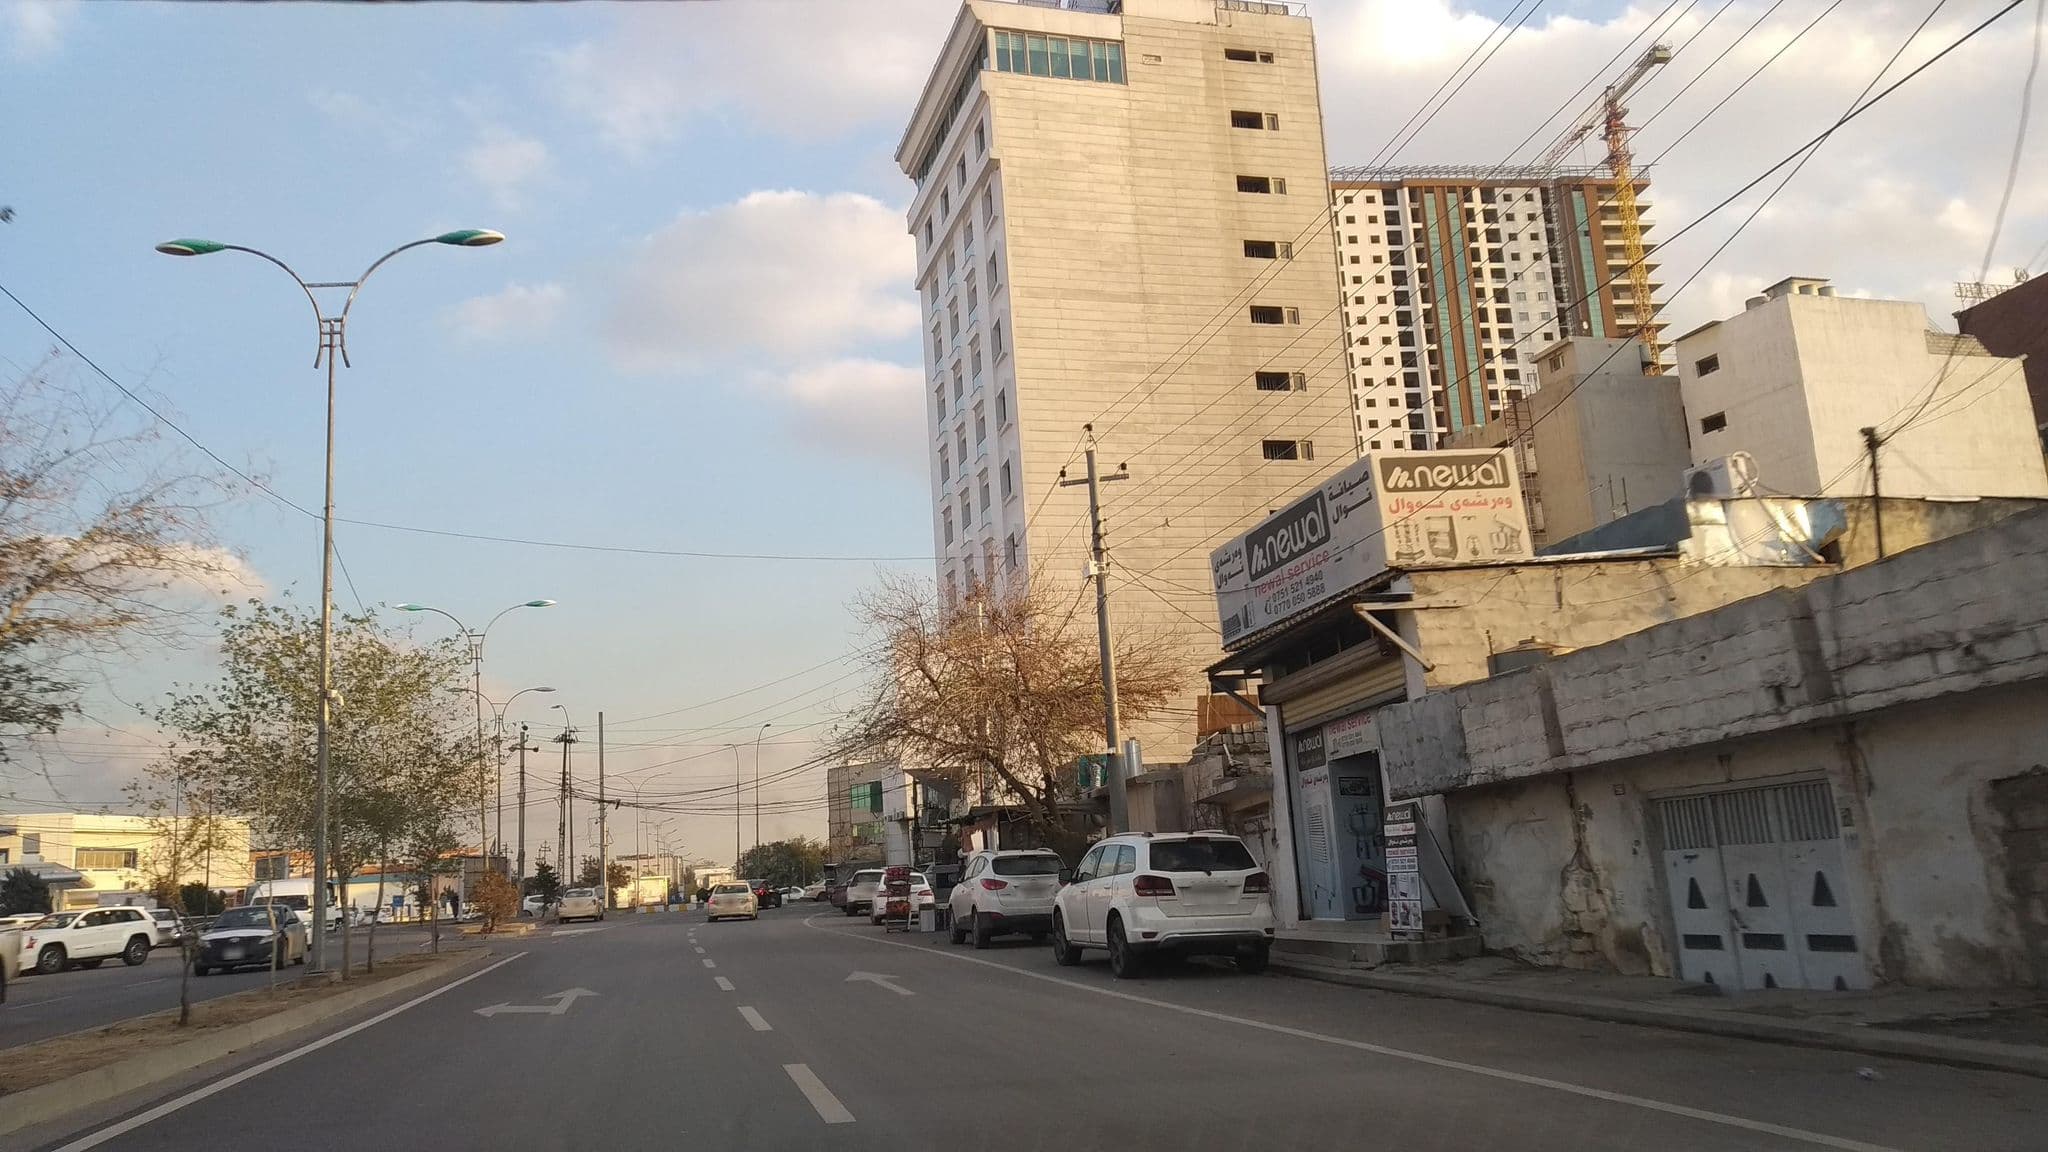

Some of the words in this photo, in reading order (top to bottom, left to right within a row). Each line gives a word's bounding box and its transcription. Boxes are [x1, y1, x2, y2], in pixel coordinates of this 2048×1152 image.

[1328, 470, 1369, 501] صيانة
[1414, 457, 1506, 488] newal
[1332, 487, 1373, 525] نوال
[1265, 507, 1326, 567] newal
[1254, 568, 1285, 597] newal
[1287, 550, 1330, 580] service
[1272, 587, 1289, 602] 0751
[1274, 599, 1291, 614] 0770
